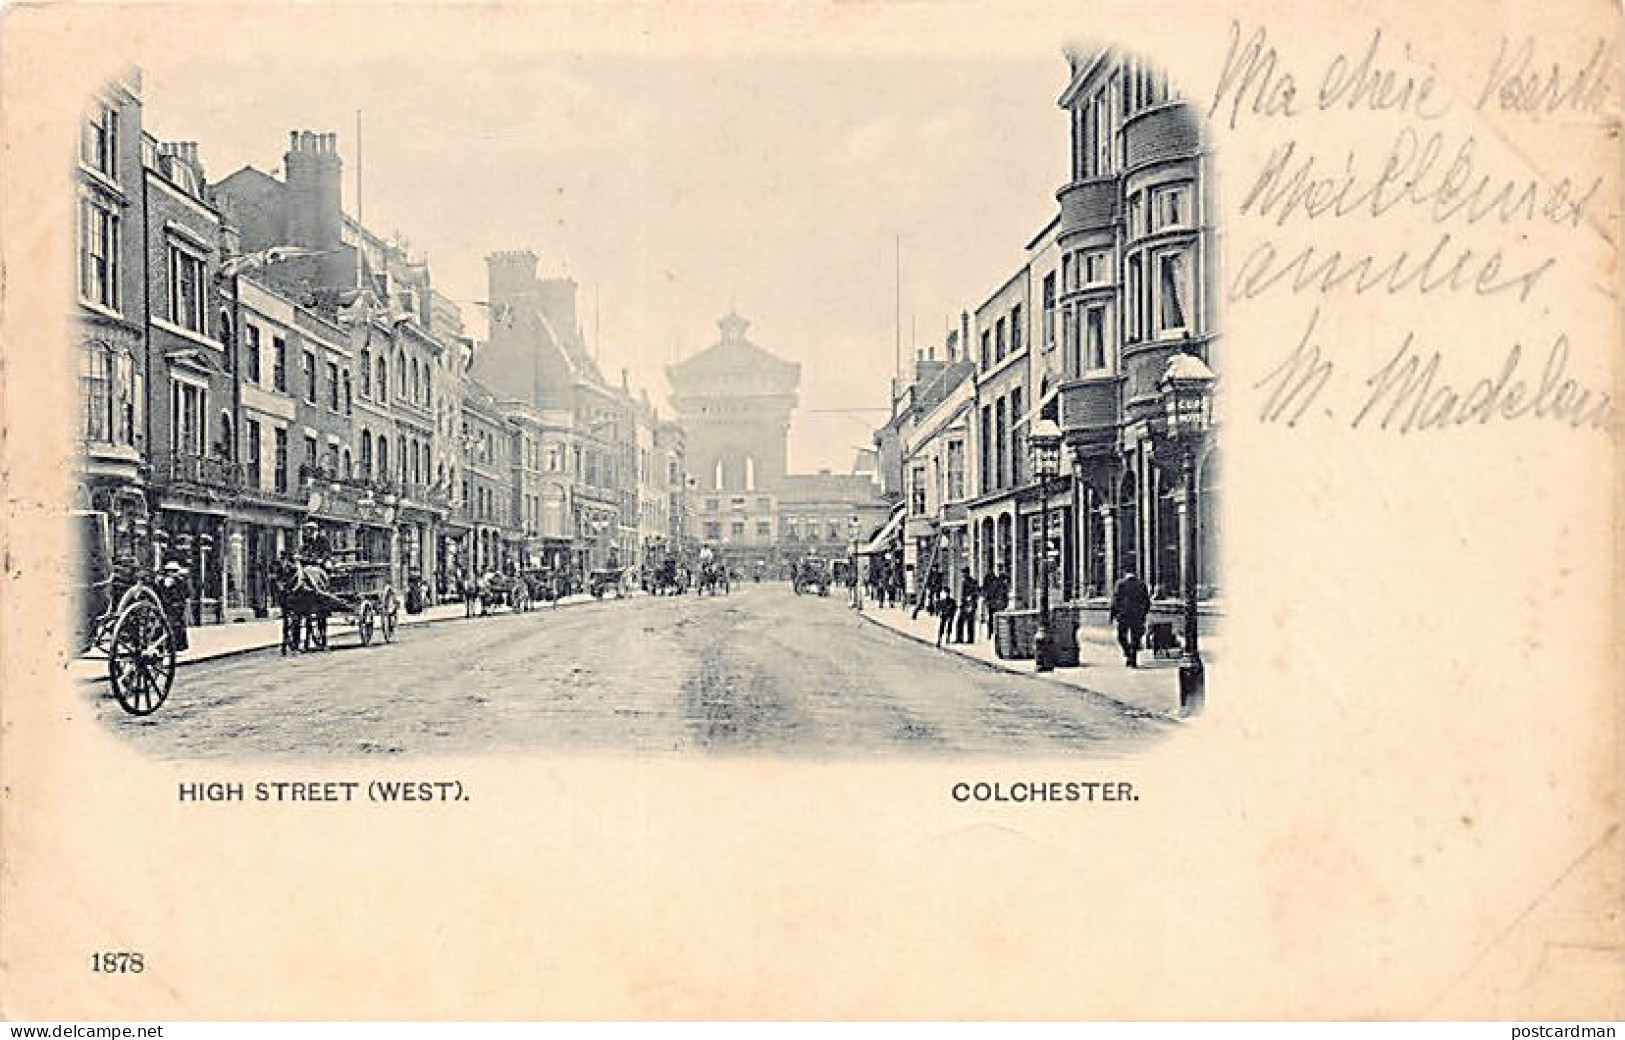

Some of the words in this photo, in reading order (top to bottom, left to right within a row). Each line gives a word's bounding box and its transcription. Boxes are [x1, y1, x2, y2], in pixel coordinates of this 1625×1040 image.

[1207, 18, 1298, 131] Ma
[178, 782, 244, 802] HIGH
[254, 782, 360, 802] STREET
[368, 780, 470, 803] (WEST).
[951, 782, 1139, 803] COLCHESTER.
[91, 952, 144, 974] 1878
